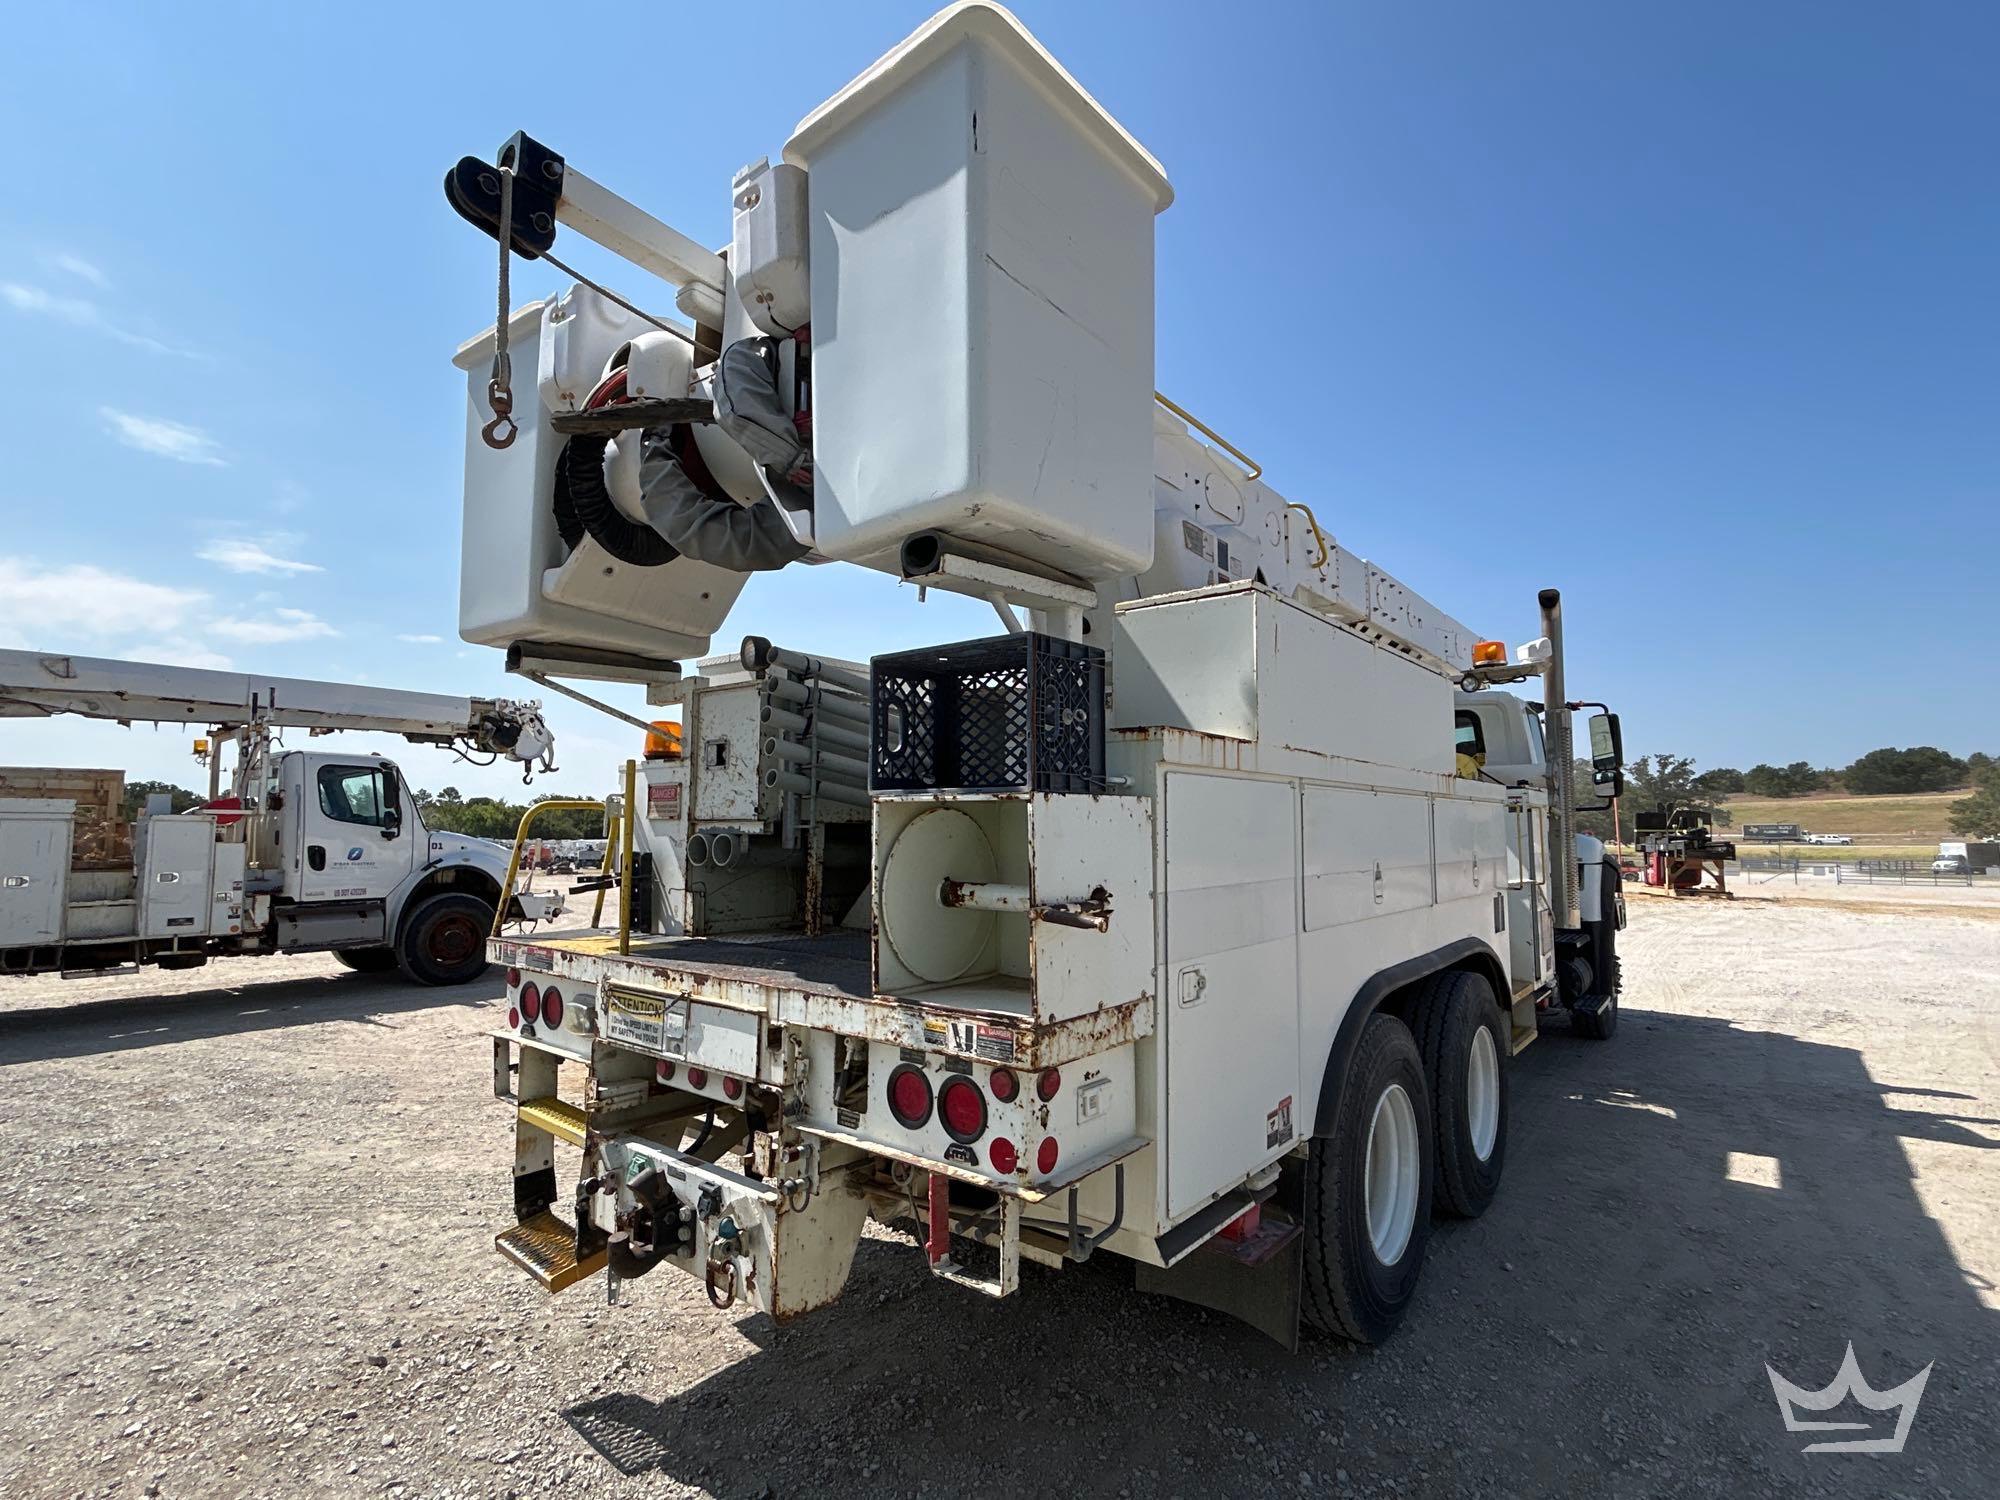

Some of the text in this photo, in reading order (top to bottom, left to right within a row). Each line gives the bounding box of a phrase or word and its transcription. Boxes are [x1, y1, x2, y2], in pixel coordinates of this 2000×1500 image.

[649, 788, 677, 799] DANGER
[431, 842, 444, 850] D1
[611, 995, 662, 1018] ATTENTION
[630, 1020, 641, 1030] SPEED
[642, 1022, 652, 1032] LIMIT
[618, 1027, 635, 1038] SAFETY
[642, 1032, 658, 1044] YOURS
[988, 1028, 1011, 1039] DANGER
